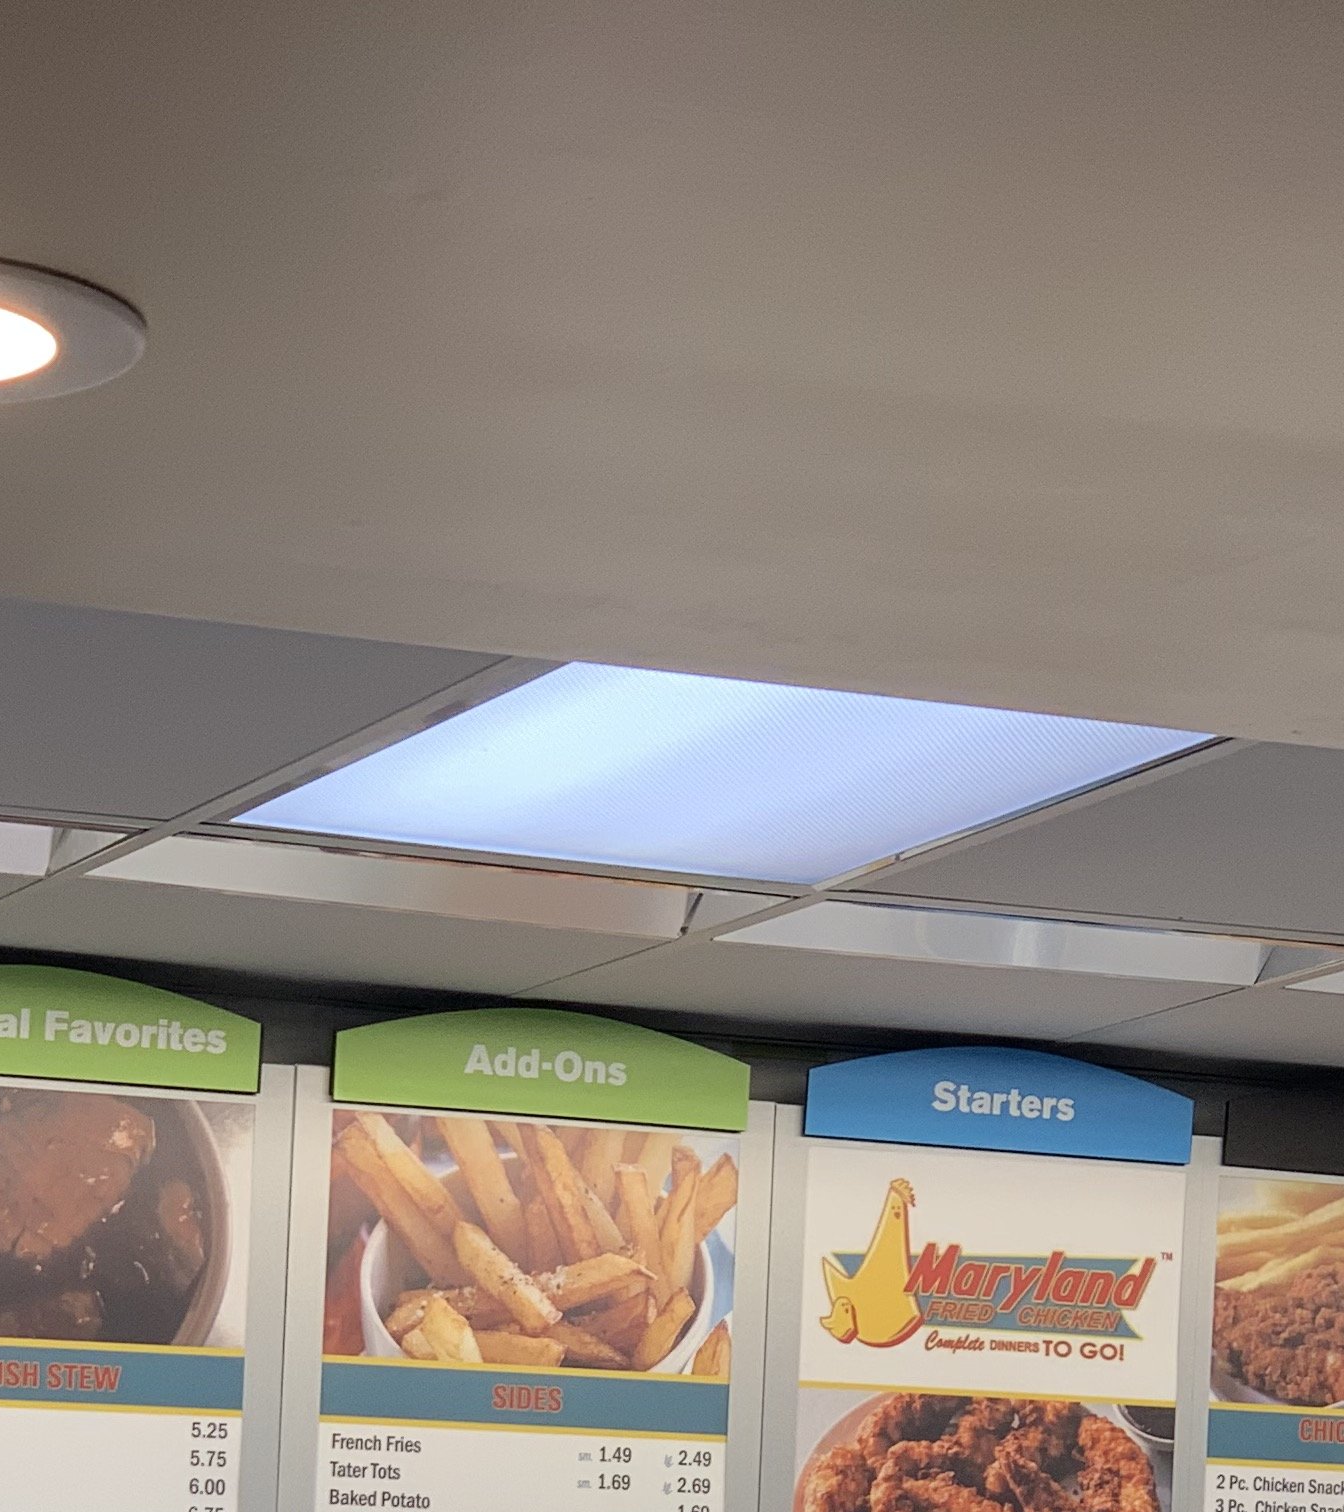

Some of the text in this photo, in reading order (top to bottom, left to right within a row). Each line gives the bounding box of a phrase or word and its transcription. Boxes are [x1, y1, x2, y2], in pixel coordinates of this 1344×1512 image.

[44, 1010, 226, 1054] Favorites
[463, 1044, 627, 1086] Add-Ons
[931, 1080, 1074, 1121] Starters
[904, 1242, 1157, 1311] Maryland
[926, 1301, 1121, 1331] FRIED CHICKEN
[924, 1330, 1125, 1362] Complete DINNERS TO GO!
[47, 1363, 119, 1390] STEW
[493, 1384, 560, 1411] SIDES
[191, 1421, 228, 1439] 5.25
[329, 1488, 377, 1506] Baked
[381, 1490, 430, 1509] Potato
